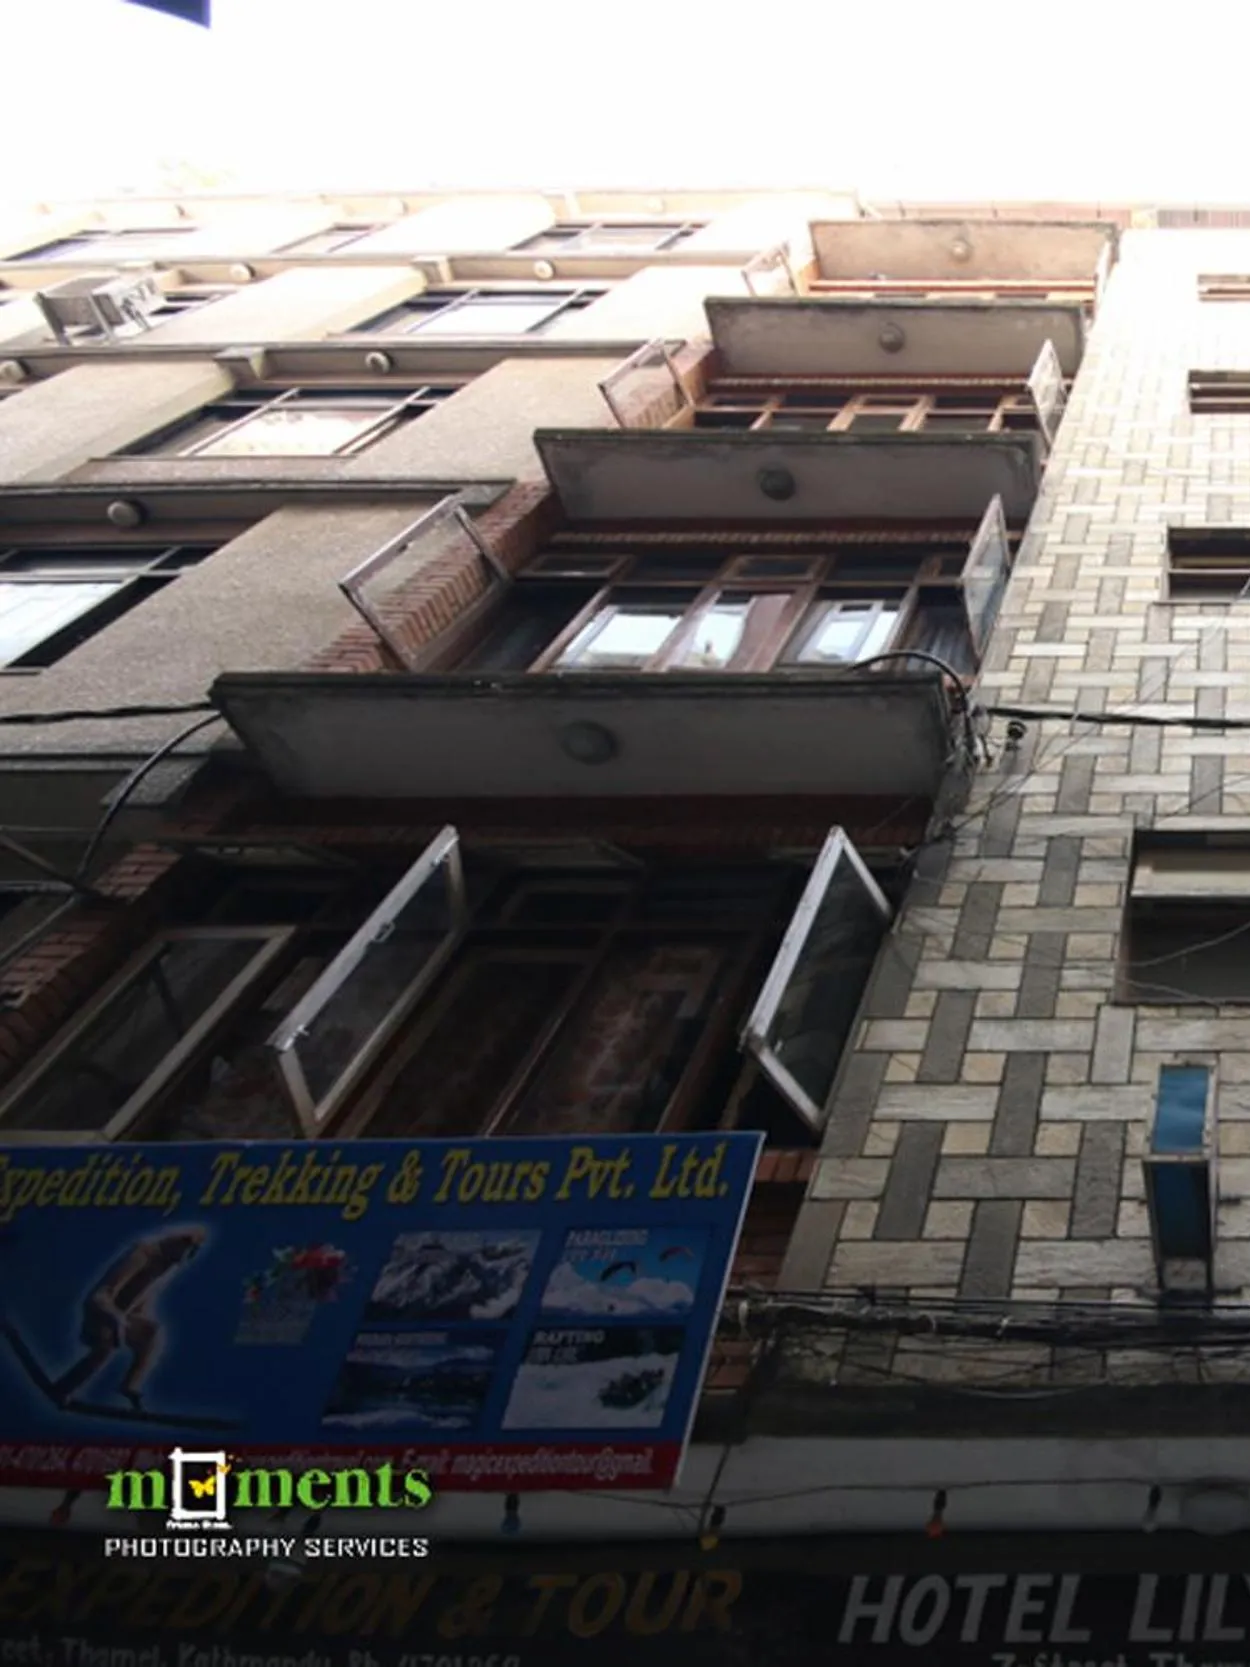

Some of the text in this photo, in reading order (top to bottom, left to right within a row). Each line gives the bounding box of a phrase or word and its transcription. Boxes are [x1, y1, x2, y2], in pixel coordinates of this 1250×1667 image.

[200, 1149, 385, 1221] Trekking
[386, 1148, 424, 1204] &
[432, 1147, 551, 1204] Tours
[554, 1145, 637, 1200] Pvt.
[648, 1140, 731, 1200] Ltd.
[532, 1329, 606, 1345] RAFTING
[436, 1572, 504, 1640] &
[519, 1569, 744, 1639] TOUR
[836, 1573, 1094, 1646] HOTEL
